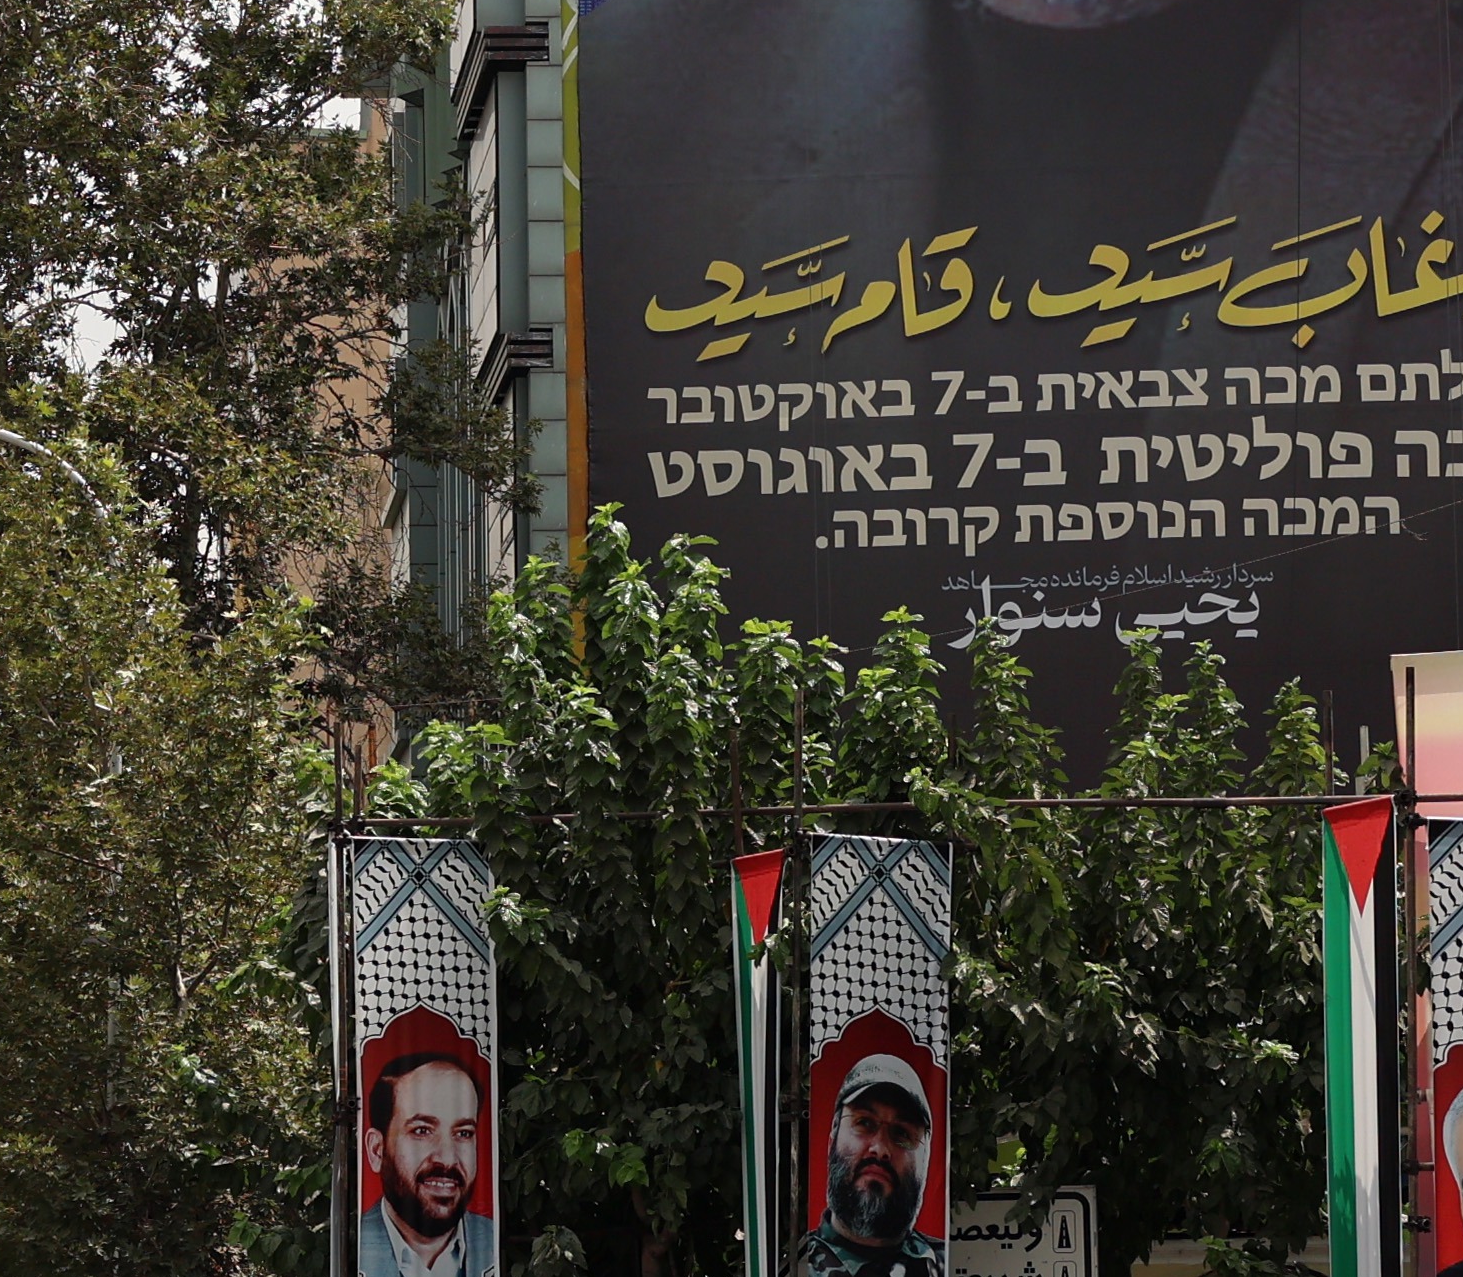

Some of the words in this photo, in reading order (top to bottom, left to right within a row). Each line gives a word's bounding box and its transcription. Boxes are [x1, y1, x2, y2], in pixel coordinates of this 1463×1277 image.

[646, 379, 916, 431] באוקטובר
[931, 370, 1023, 415] ב-7
[1036, 367, 1209, 412] צבאית
[1224, 364, 1341, 405] מכה
[647, 442, 933, 499] באוגוסט
[952, 433, 1067, 489] ב-7
[1099, 415, 1374, 485] פוליטית
[815, 505, 999, 557] קרובה.
[1014, 496, 1226, 543] הנוספת
[1243, 496, 1400, 536] המכה
[1051, 564, 1121, 592] فرمانده
[1122, 564, 1173, 595] اسلام
[1222, 563, 1274, 590] سردار
[947, 574, 1102, 649] سنوار
